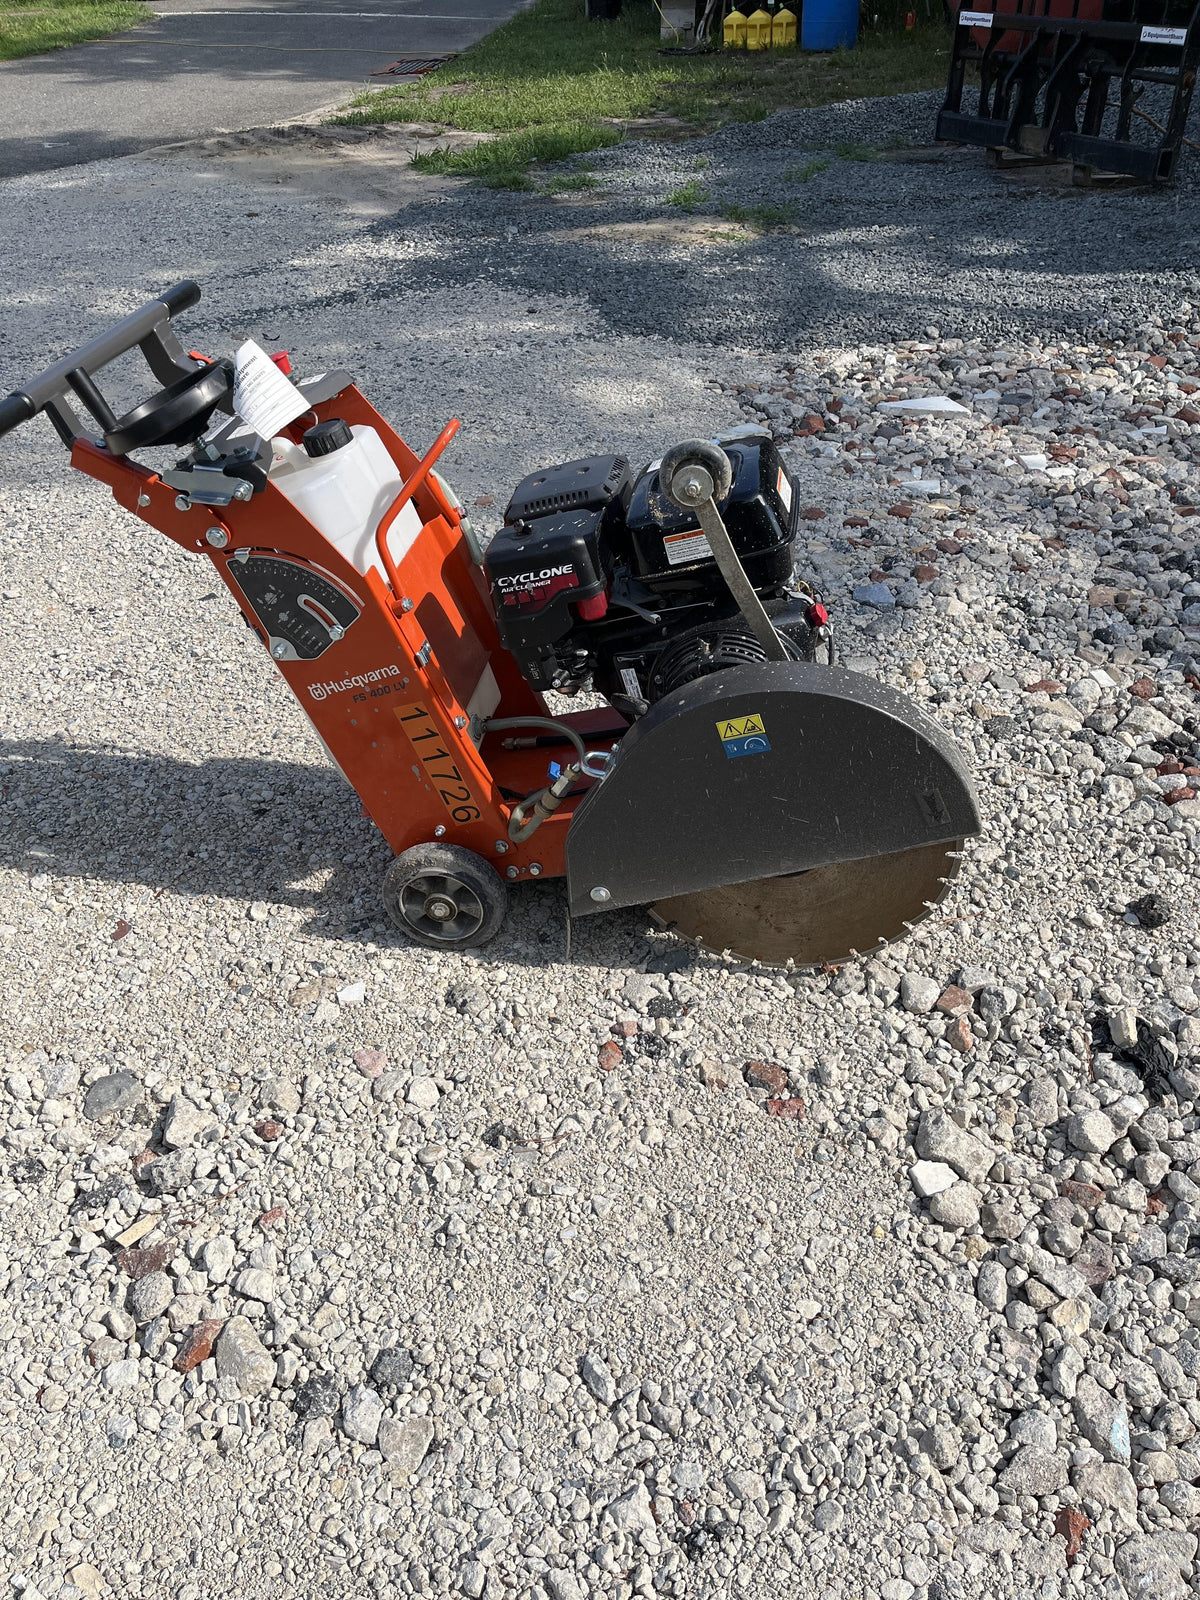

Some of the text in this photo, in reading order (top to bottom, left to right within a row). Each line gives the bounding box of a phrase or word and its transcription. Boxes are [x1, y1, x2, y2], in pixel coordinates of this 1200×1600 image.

[498, 564, 573, 587] CYCLONE
[323, 664, 400, 695] Husqvarna
[352, 692, 367, 704] FS
[370, 685, 392, 698] 400
[400, 707, 481, 823] 111726
